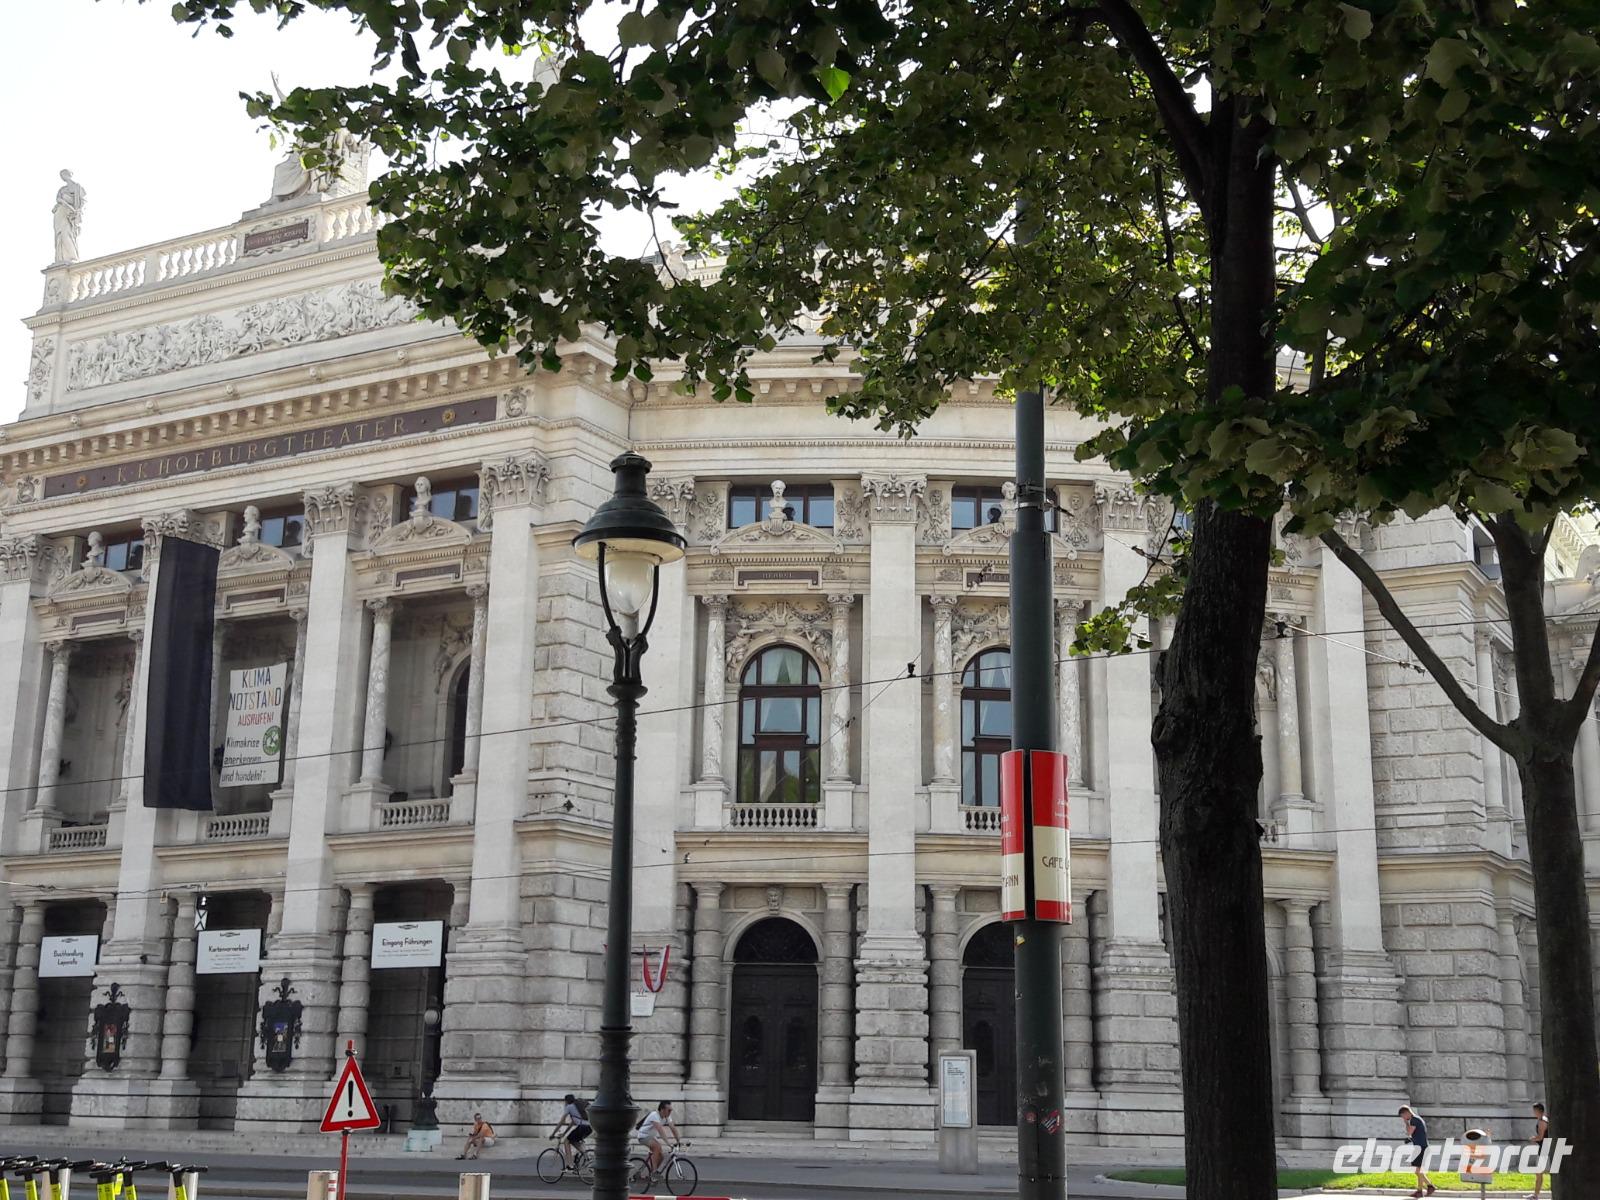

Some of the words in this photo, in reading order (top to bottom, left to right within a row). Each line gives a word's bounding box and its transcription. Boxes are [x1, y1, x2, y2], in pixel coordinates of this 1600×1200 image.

[158, 416, 408, 475] HOFBURGTHEATER
[242, 666, 271, 688] KLIMA
[229, 687, 281, 711] NOTSTAND
